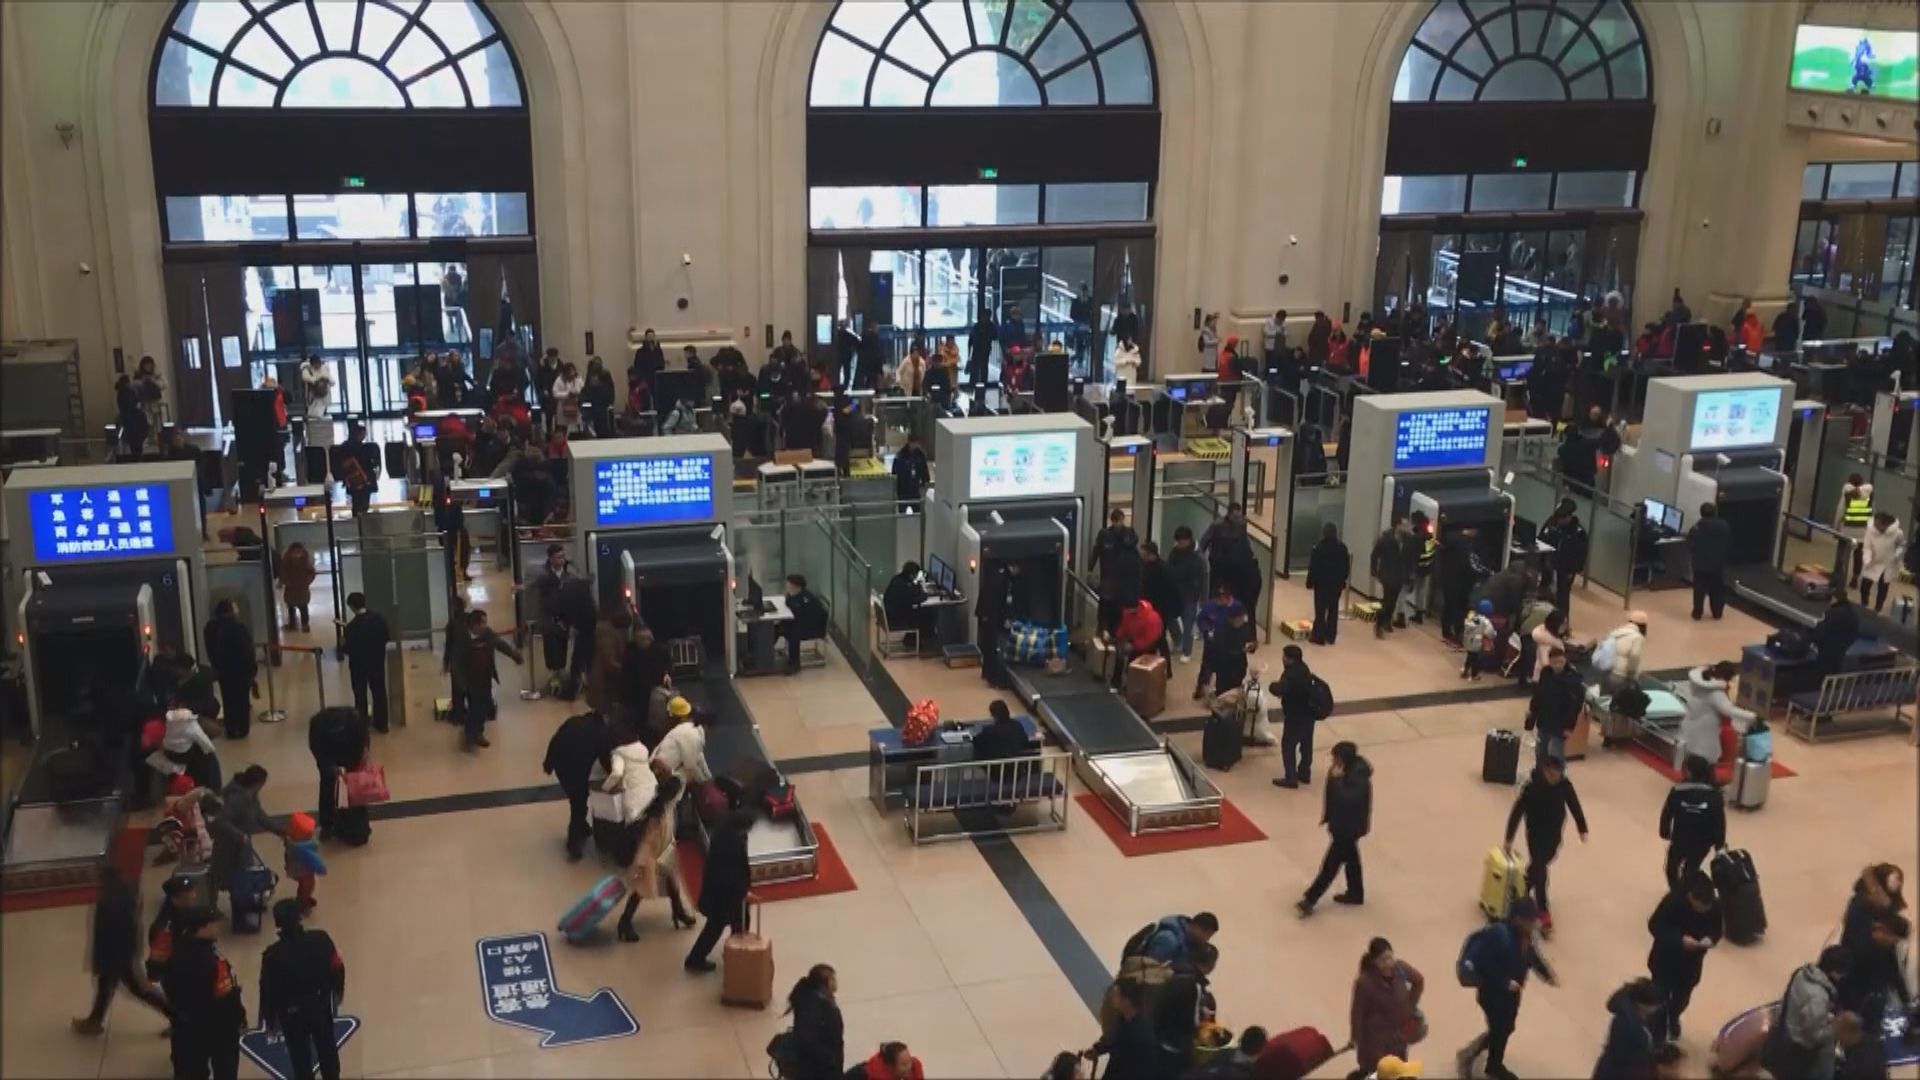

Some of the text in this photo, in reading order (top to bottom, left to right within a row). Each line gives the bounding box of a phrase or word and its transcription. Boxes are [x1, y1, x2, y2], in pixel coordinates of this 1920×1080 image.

[51, 488, 149, 505] 军人通道
[52, 505, 151, 522] 急客通道
[54, 521, 152, 538] 商务座通道
[57, 537, 154, 553] 消防救援人员通道
[602, 544, 611, 555] 5
[162, 575, 172, 585] 6
[503, 955, 528, 964] A3
[491, 978, 547, 998] 通道
